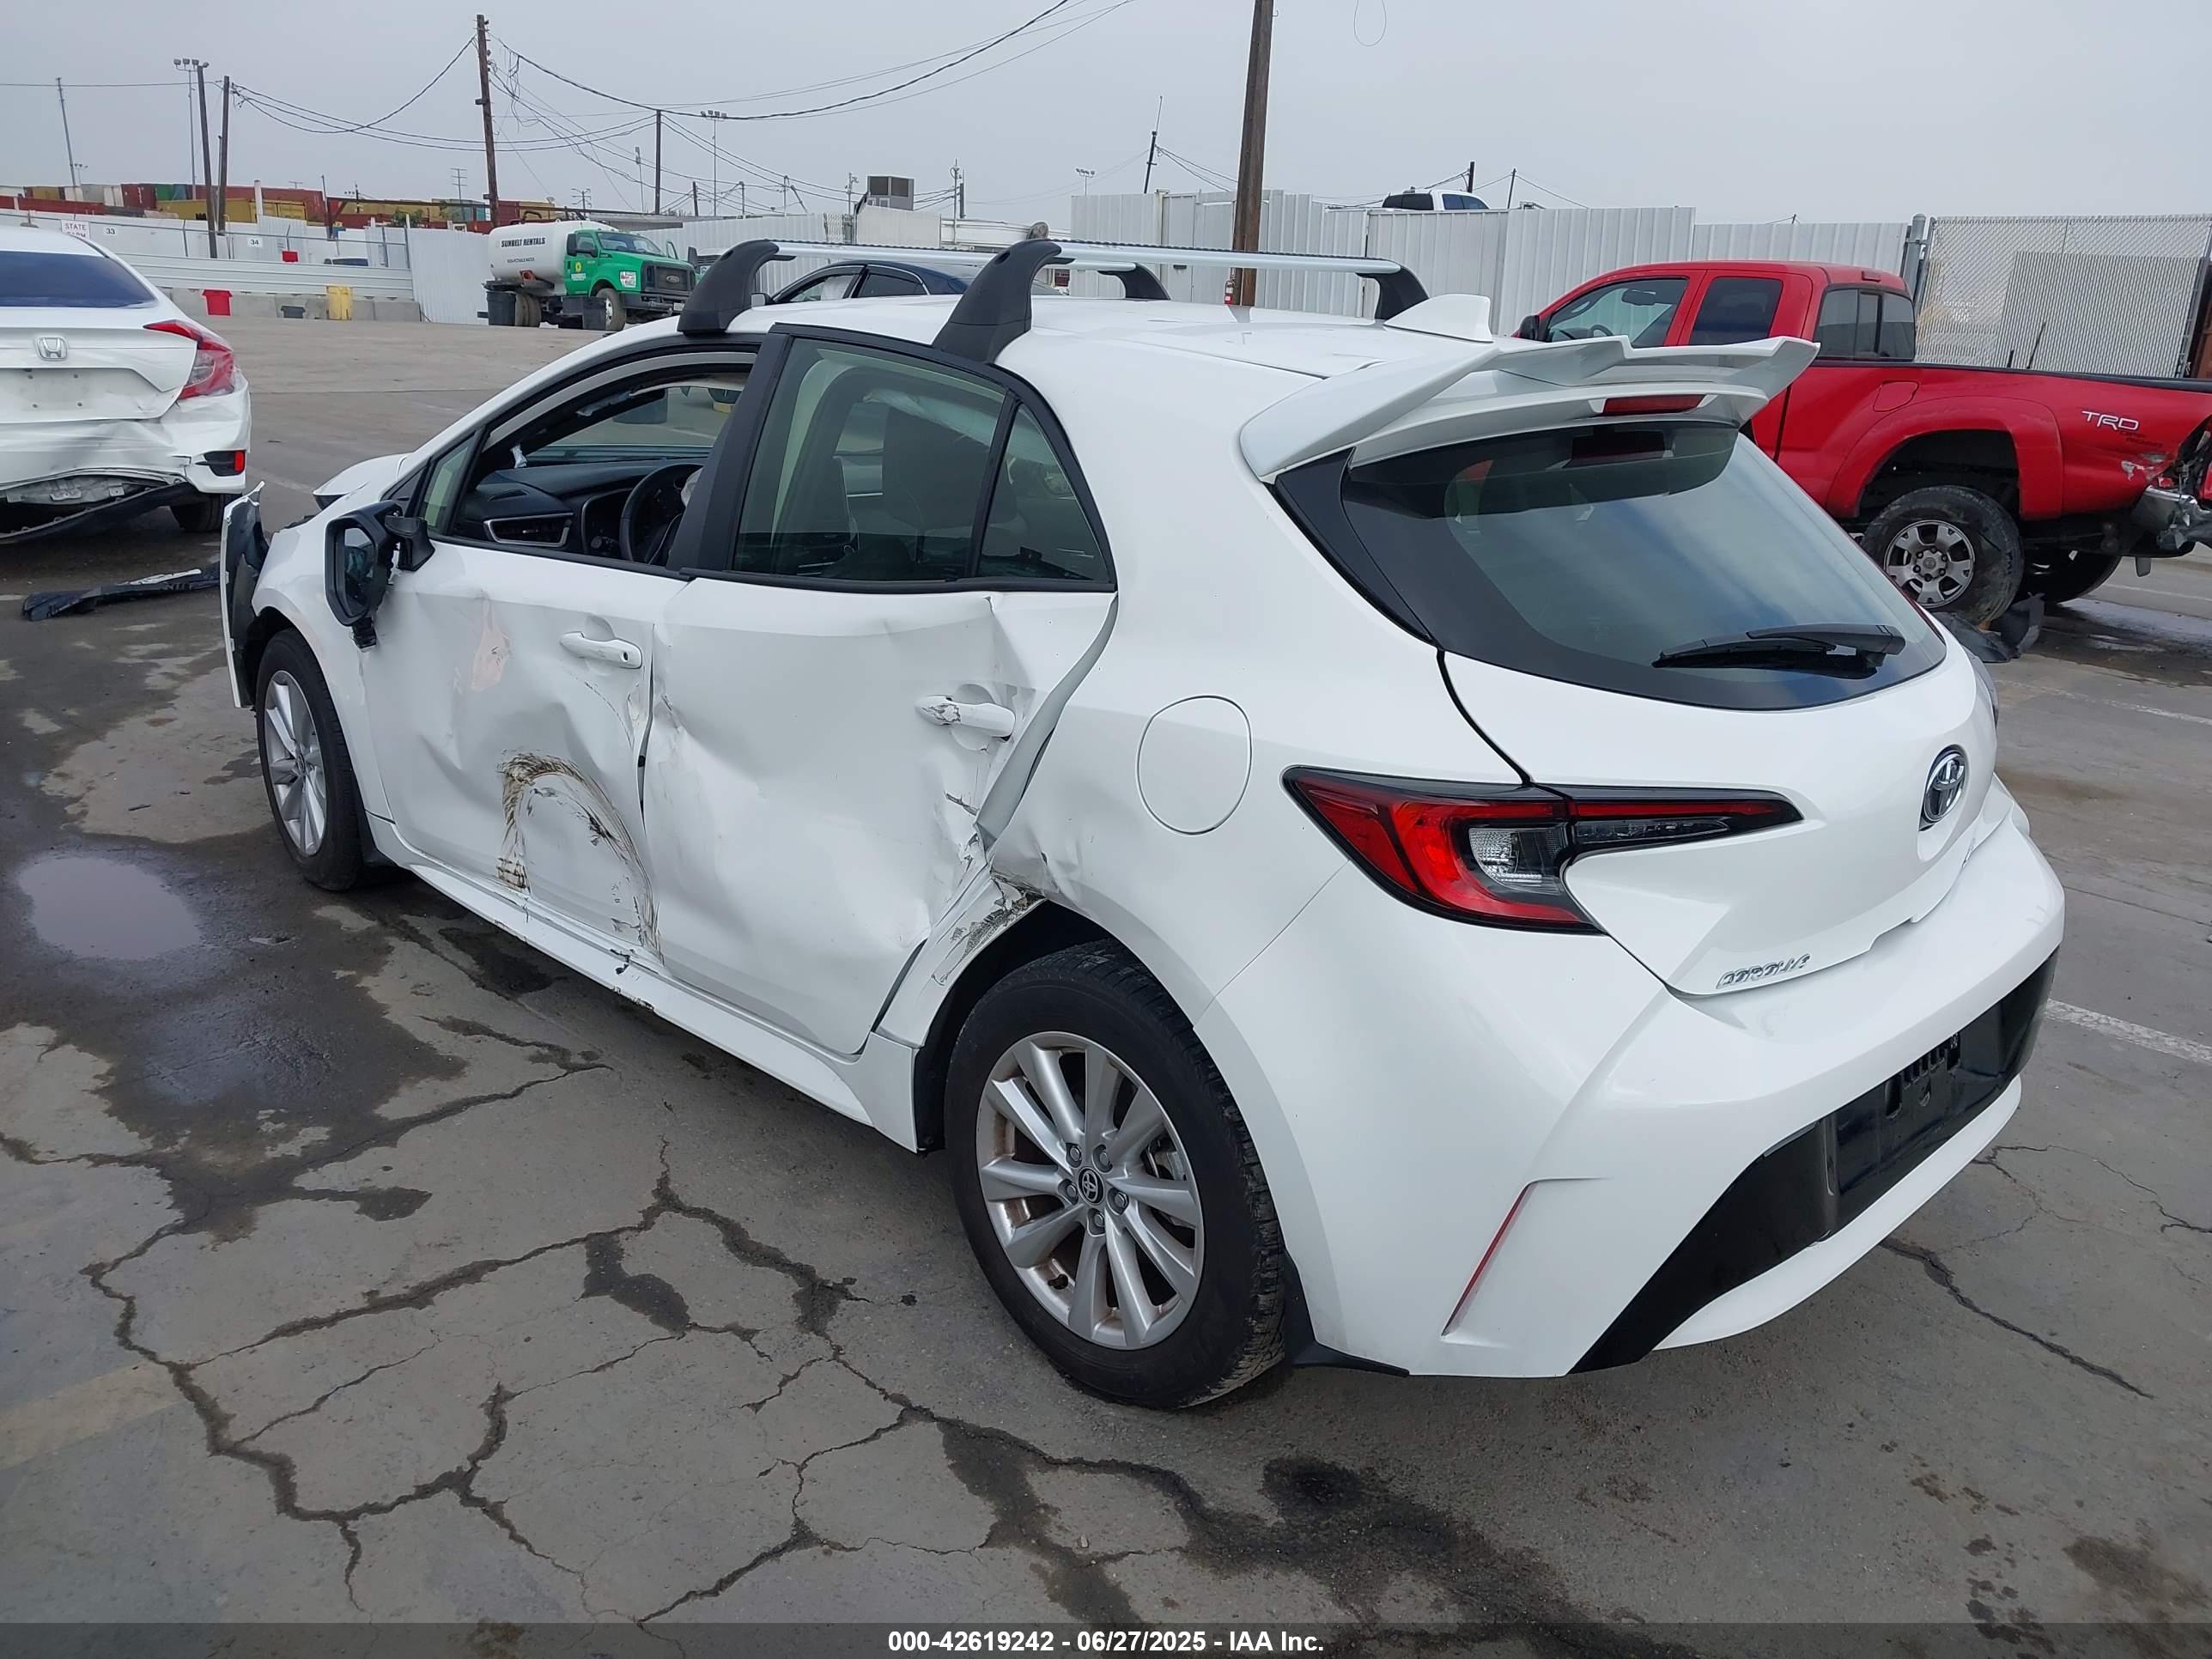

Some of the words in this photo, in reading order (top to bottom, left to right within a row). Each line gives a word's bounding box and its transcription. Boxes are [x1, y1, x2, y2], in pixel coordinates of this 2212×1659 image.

[64, 222, 87, 231] STATE
[501, 239, 523, 248] SUNBELT
[523, 237, 546, 246] RENTALS
[2081, 410, 2139, 431] TRD
